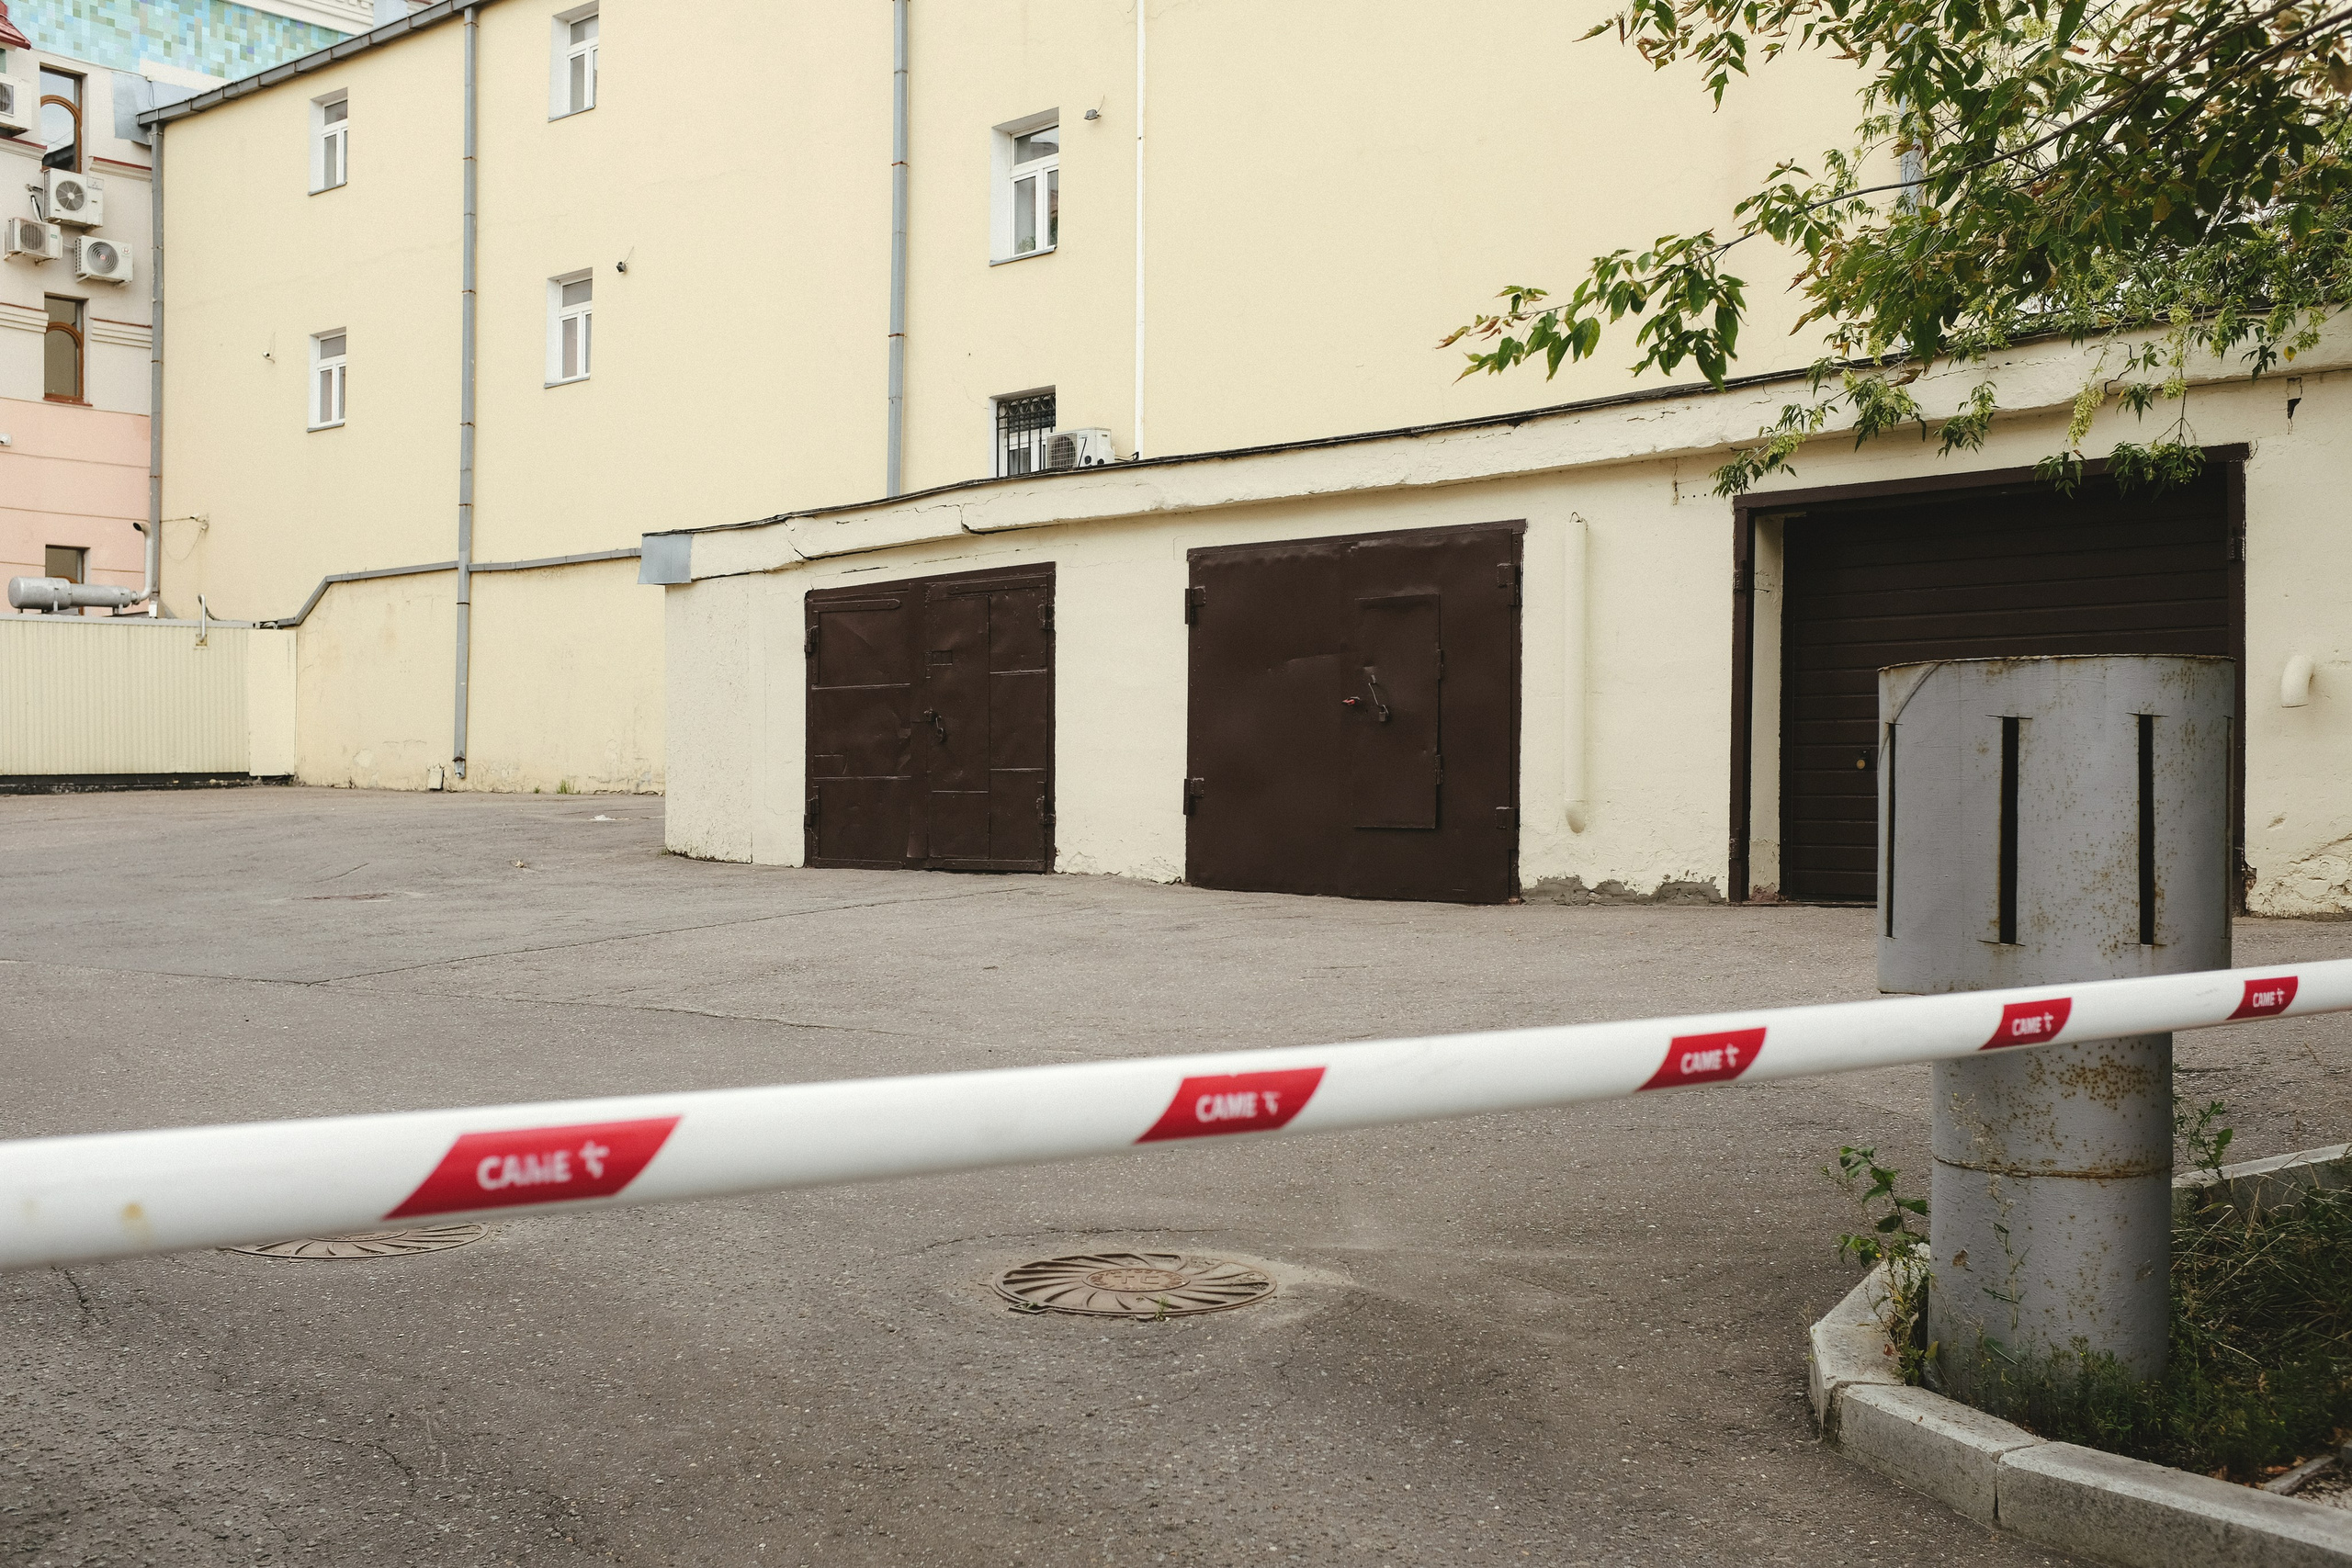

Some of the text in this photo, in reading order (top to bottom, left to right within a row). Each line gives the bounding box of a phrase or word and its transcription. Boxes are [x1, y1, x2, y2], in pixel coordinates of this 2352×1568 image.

[2253, 991, 2276, 1008] CAME
[2012, 1016, 2042, 1036] CAME
[1679, 1049, 1724, 1075] CAME
[1195, 1091, 1259, 1122] CAME
[476, 1150, 572, 1190] CAME
